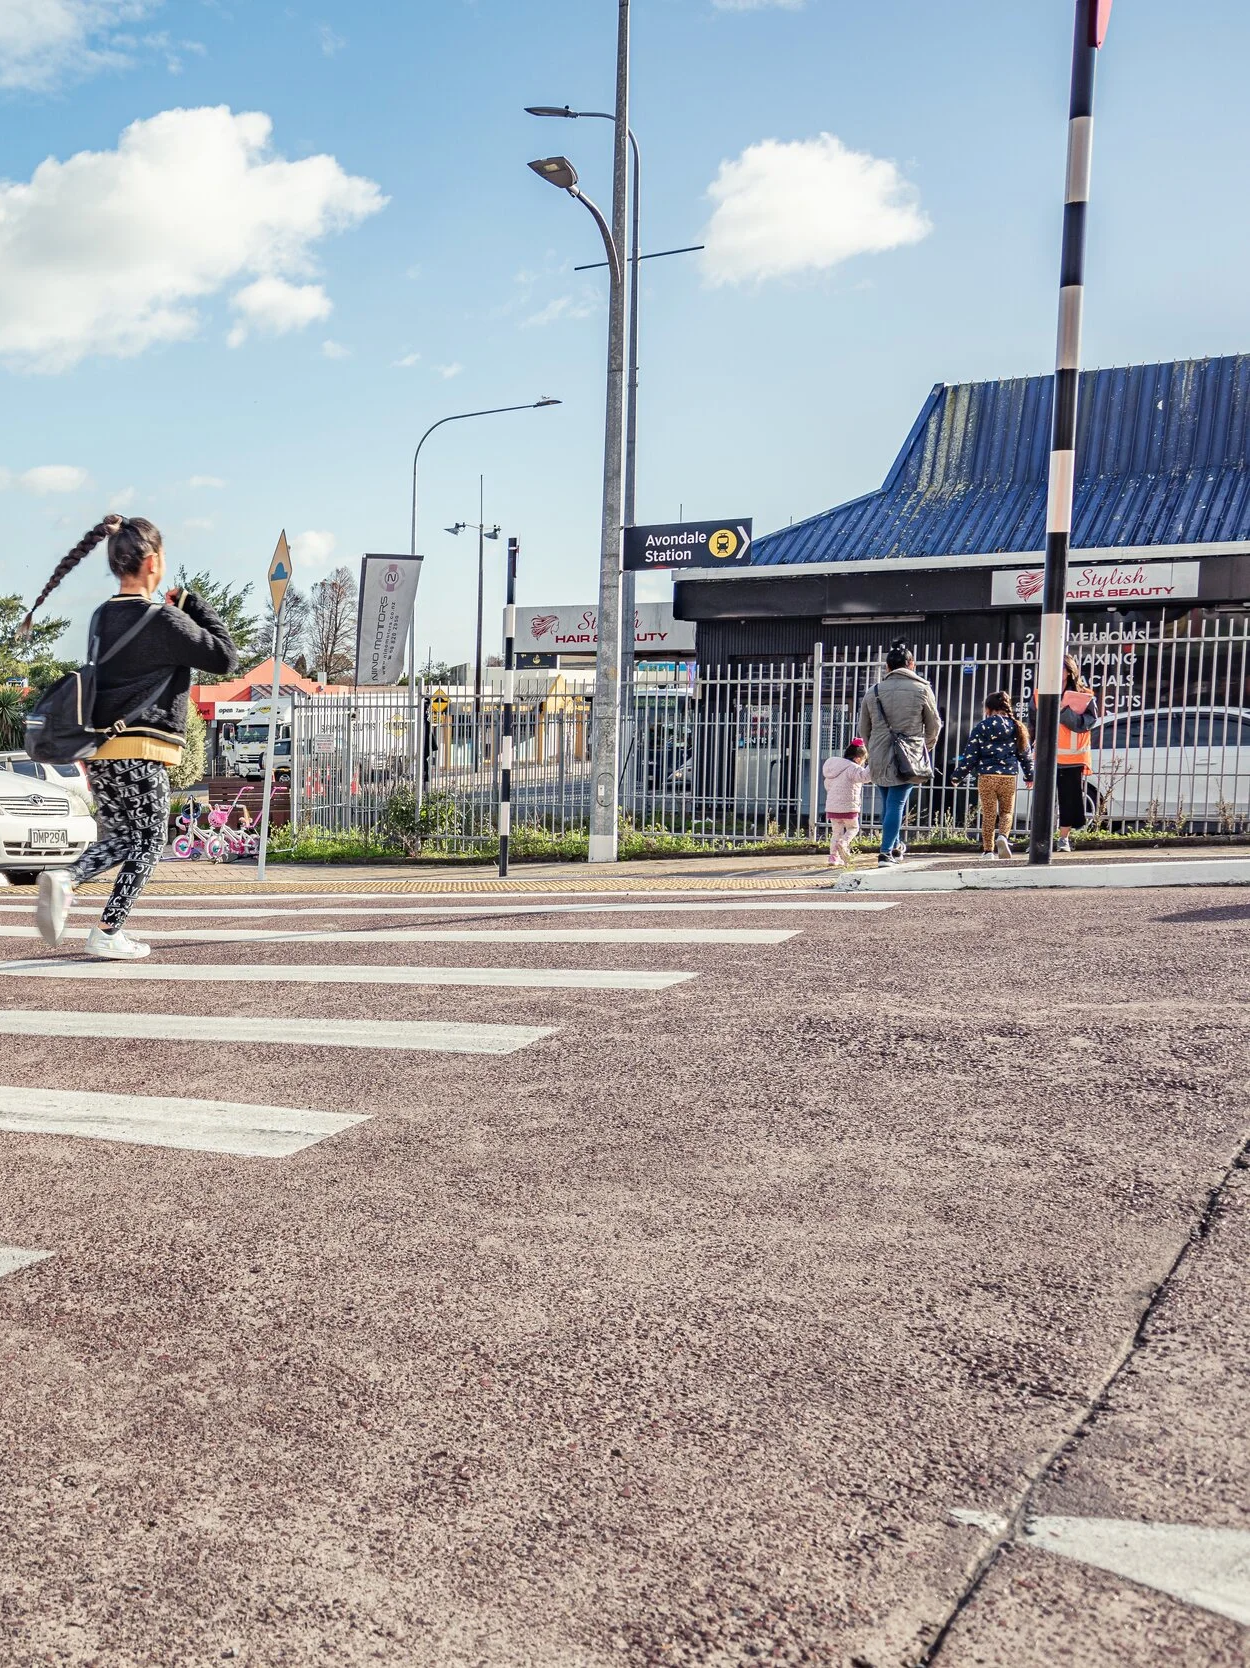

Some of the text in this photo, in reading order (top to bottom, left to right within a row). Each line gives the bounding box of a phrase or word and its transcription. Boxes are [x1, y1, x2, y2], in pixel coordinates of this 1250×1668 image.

[645, 531, 707, 547] Avondale
[645, 549, 692, 562] Station
[1076, 567, 1148, 588] Stylish
[1065, 587, 1175, 599] AIR & BEAUTY
[371, 596, 388, 681] NINO MOTORS
[382, 601, 396, 675] www.ninomotors.co.nz
[555, 634, 590, 643] HAIR
[1081, 675, 1135, 687] ACIALS
